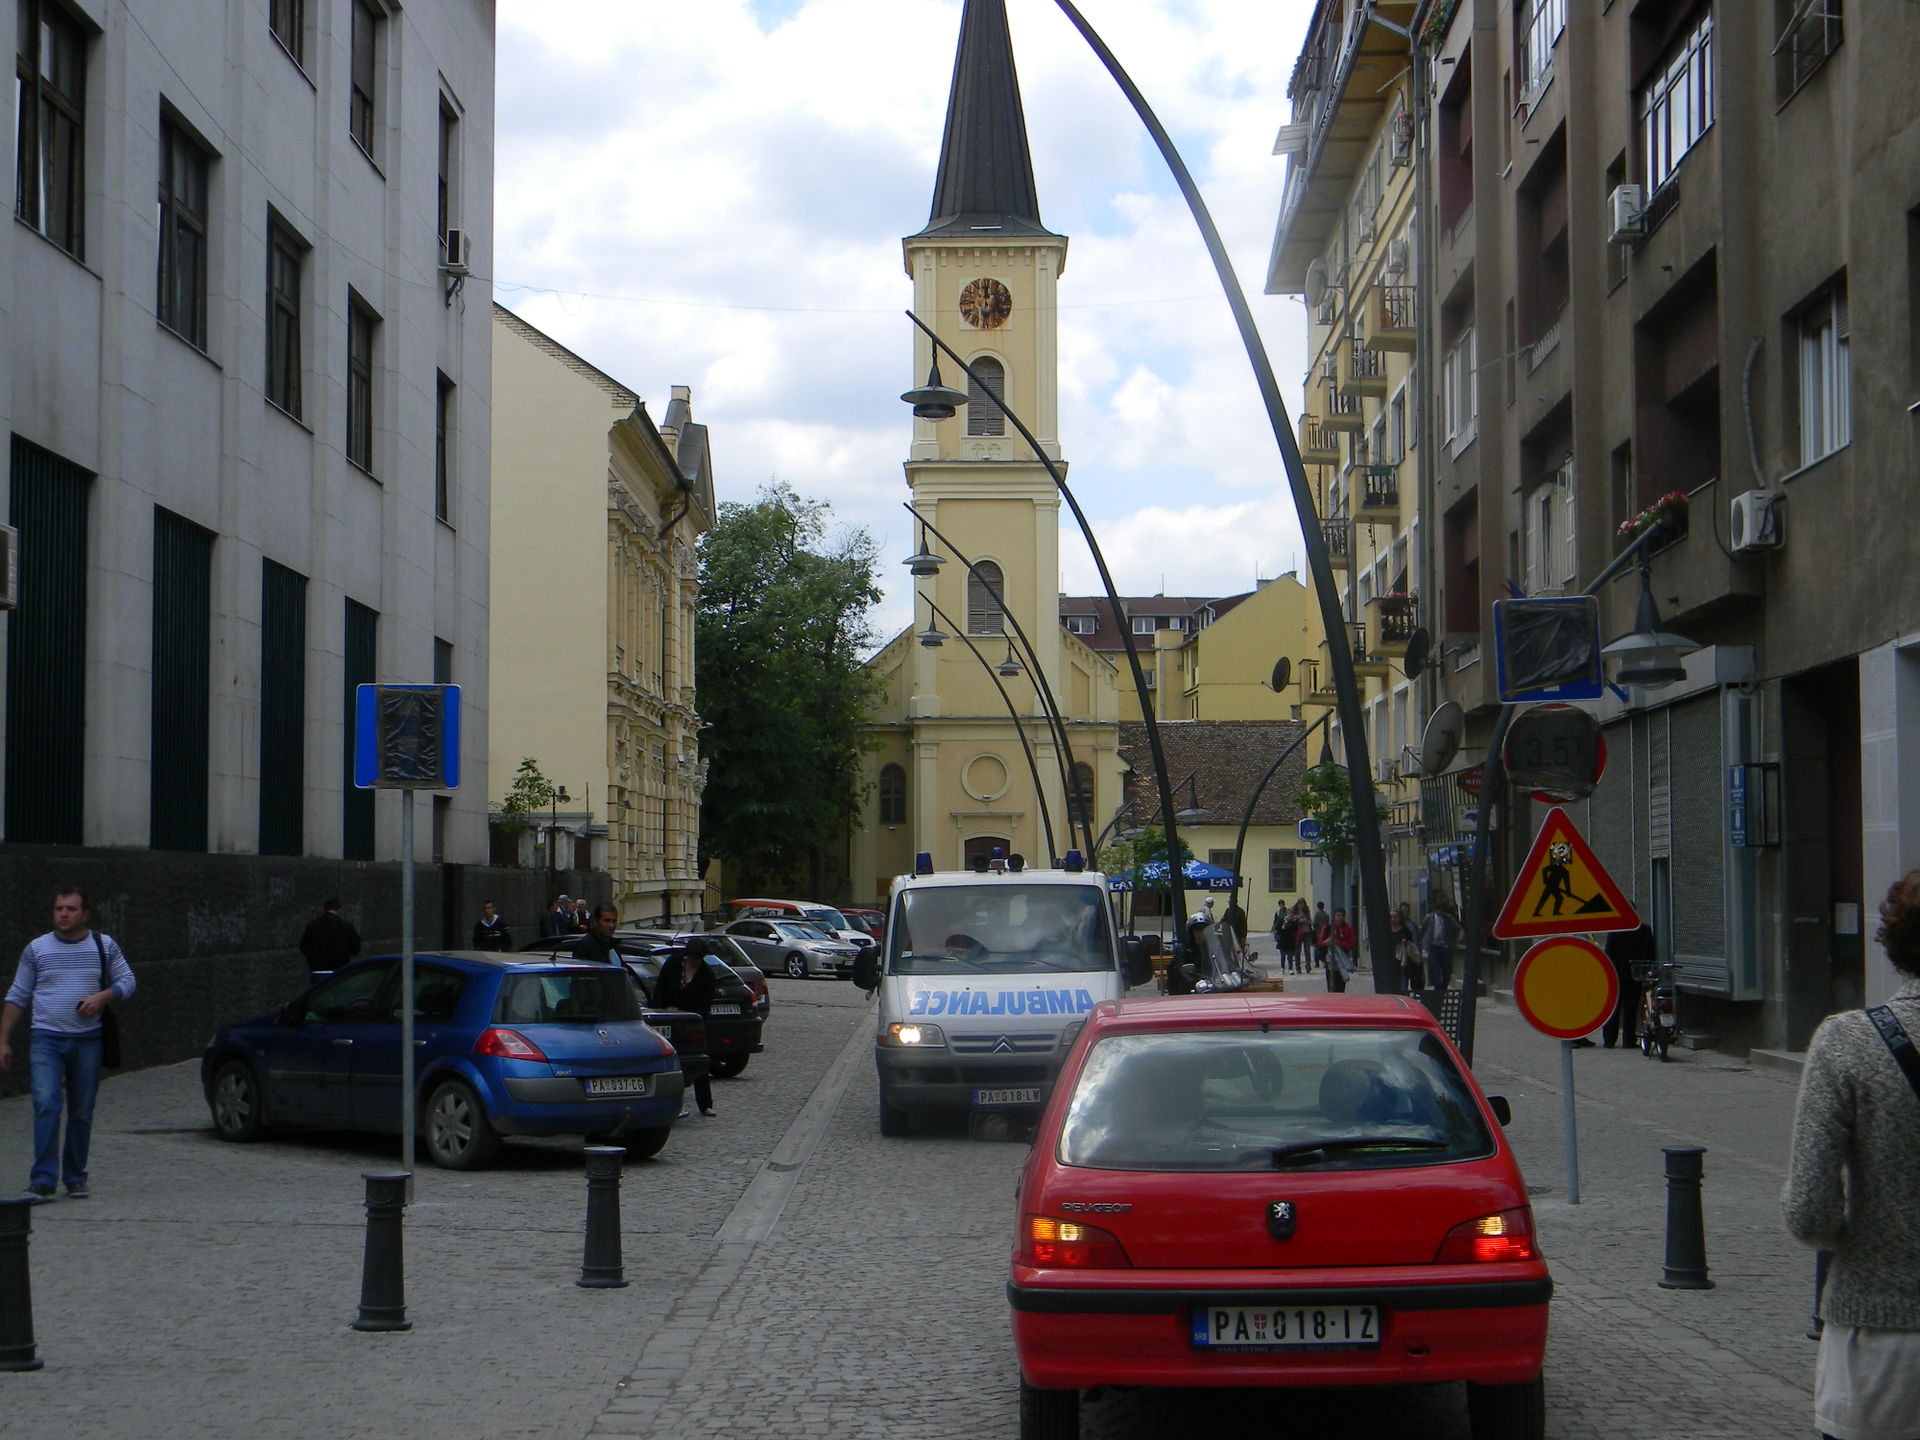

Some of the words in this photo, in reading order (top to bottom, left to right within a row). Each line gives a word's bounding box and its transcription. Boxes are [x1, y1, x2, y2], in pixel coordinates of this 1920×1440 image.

[592, 1079, 605, 1092] PA
[980, 1091, 994, 1103] PA
[1061, 1202, 1133, 1214] PEUGEOT
[1214, 1310, 1250, 1340] PA
[1193, 1332, 1208, 1341] SRB
